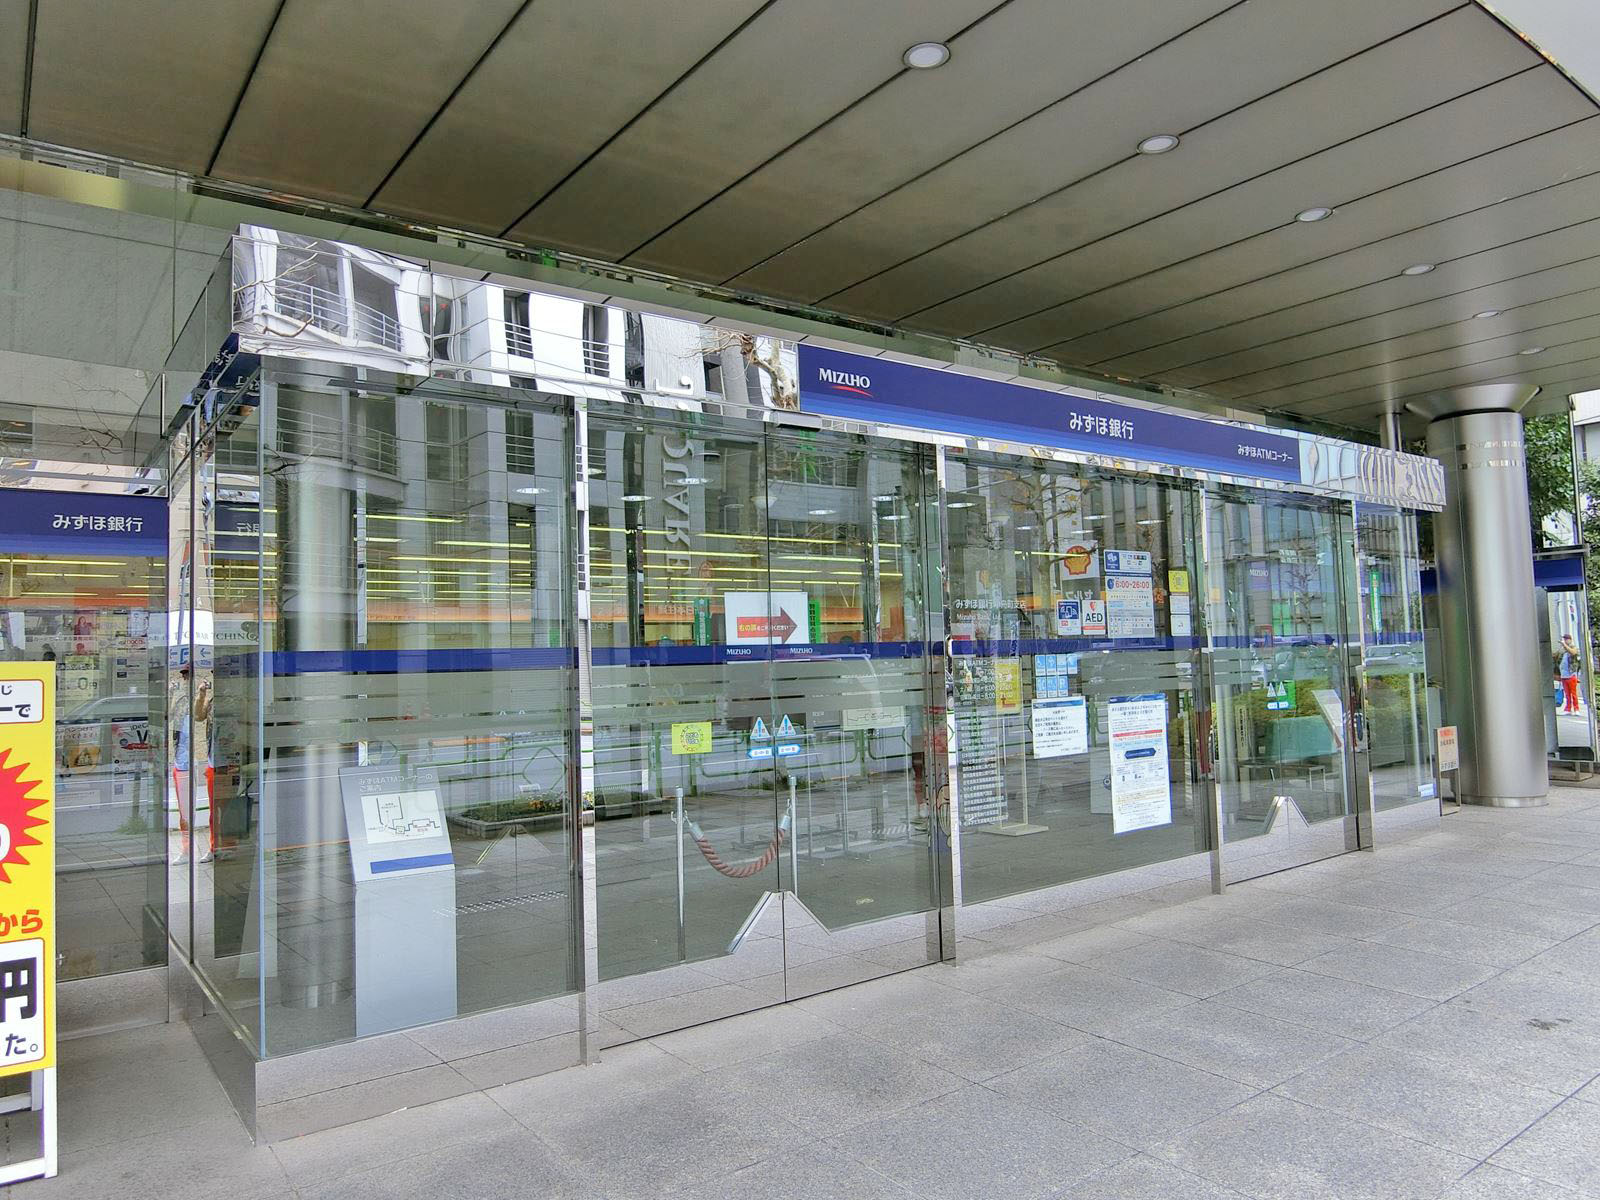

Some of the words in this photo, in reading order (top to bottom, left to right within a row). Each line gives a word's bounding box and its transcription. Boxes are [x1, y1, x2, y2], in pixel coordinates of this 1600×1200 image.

[818, 368, 870, 388] MIZUHO
[1070, 412, 1134, 440] みずほ銀行
[1237, 444, 1294, 462] みずほATMコーナー
[52, 514, 144, 532] みずほ銀行
[1085, 613, 1103, 623] AED
[1, 685, 12, 695] じ
[0, 957, 37, 1022] 円
